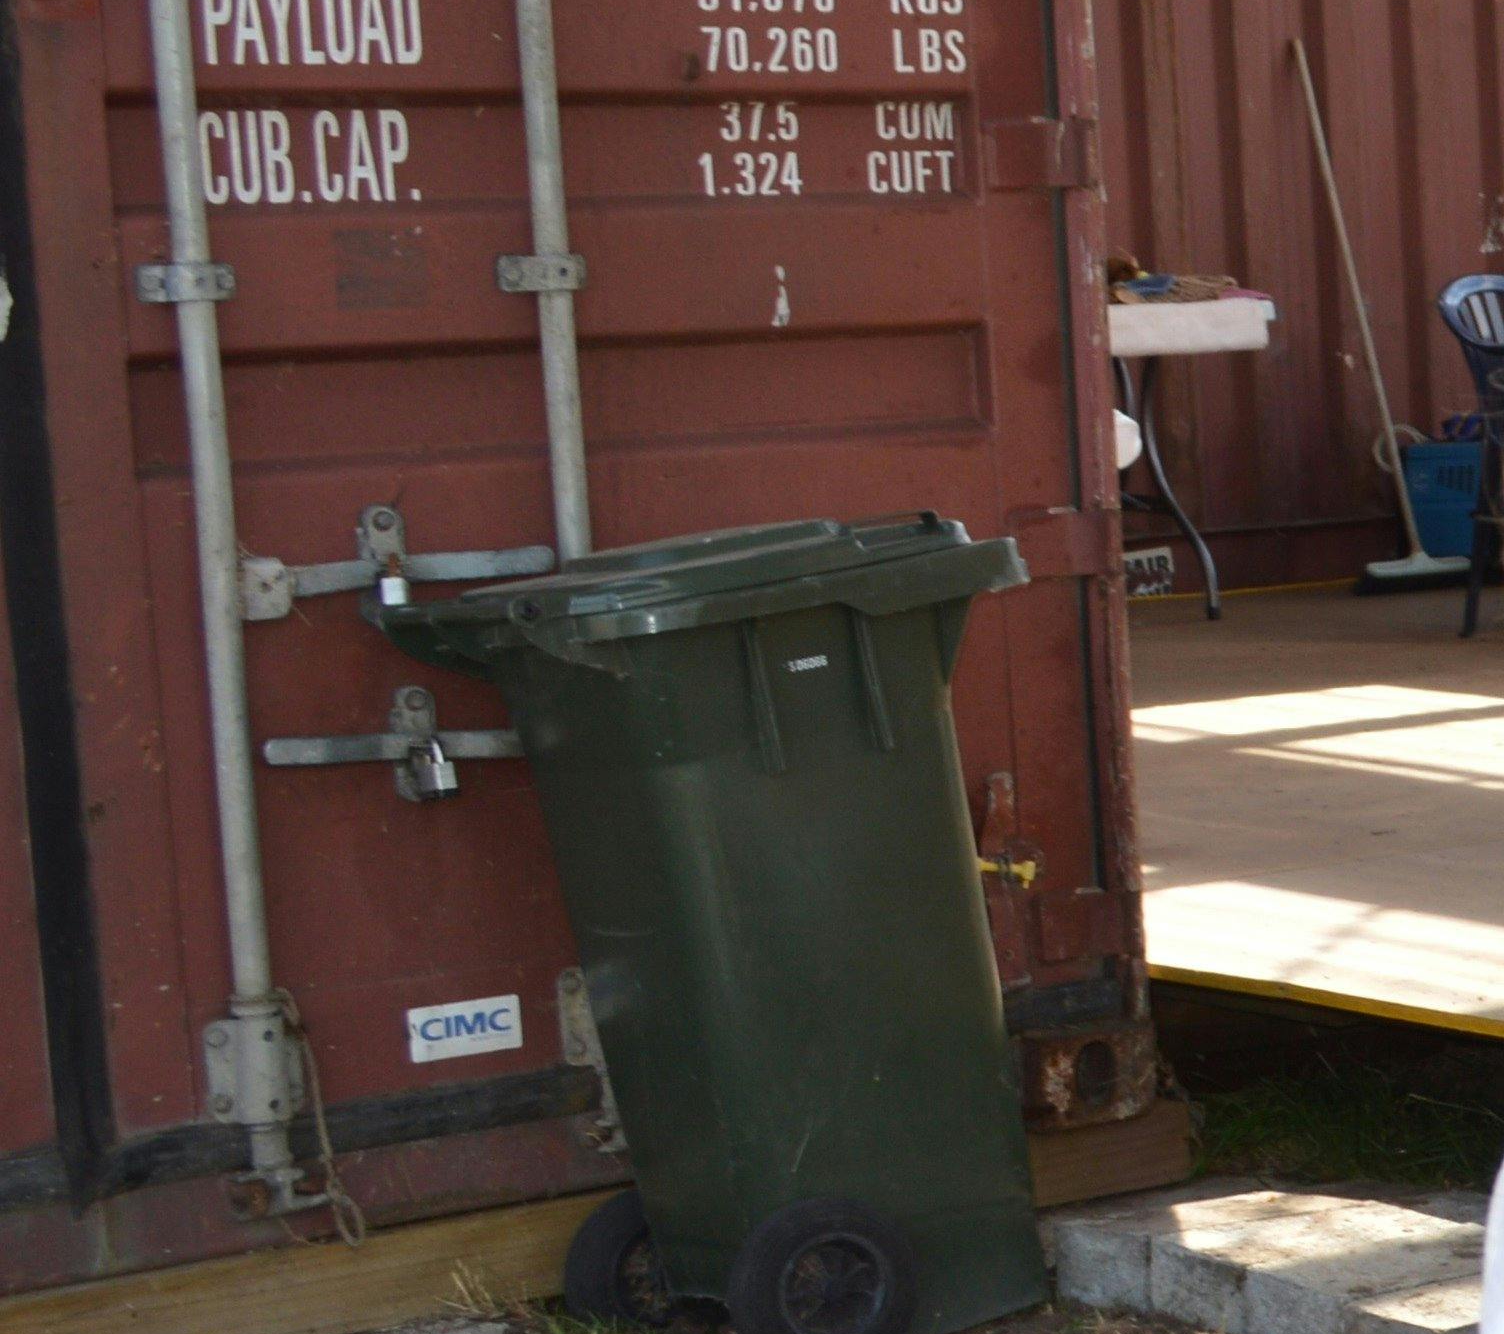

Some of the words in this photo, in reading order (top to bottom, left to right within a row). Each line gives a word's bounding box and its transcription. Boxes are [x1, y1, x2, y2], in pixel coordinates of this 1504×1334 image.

[700, 25, 839, 74] 70.260
[892, 28, 967, 74] LBS
[719, 100, 800, 142] 37.5
[875, 100, 955, 141] CUM
[697, 150, 803, 197] 1.324
[866, 150, 955, 194] CUFT
[419, 1007, 513, 1042] CIMC
